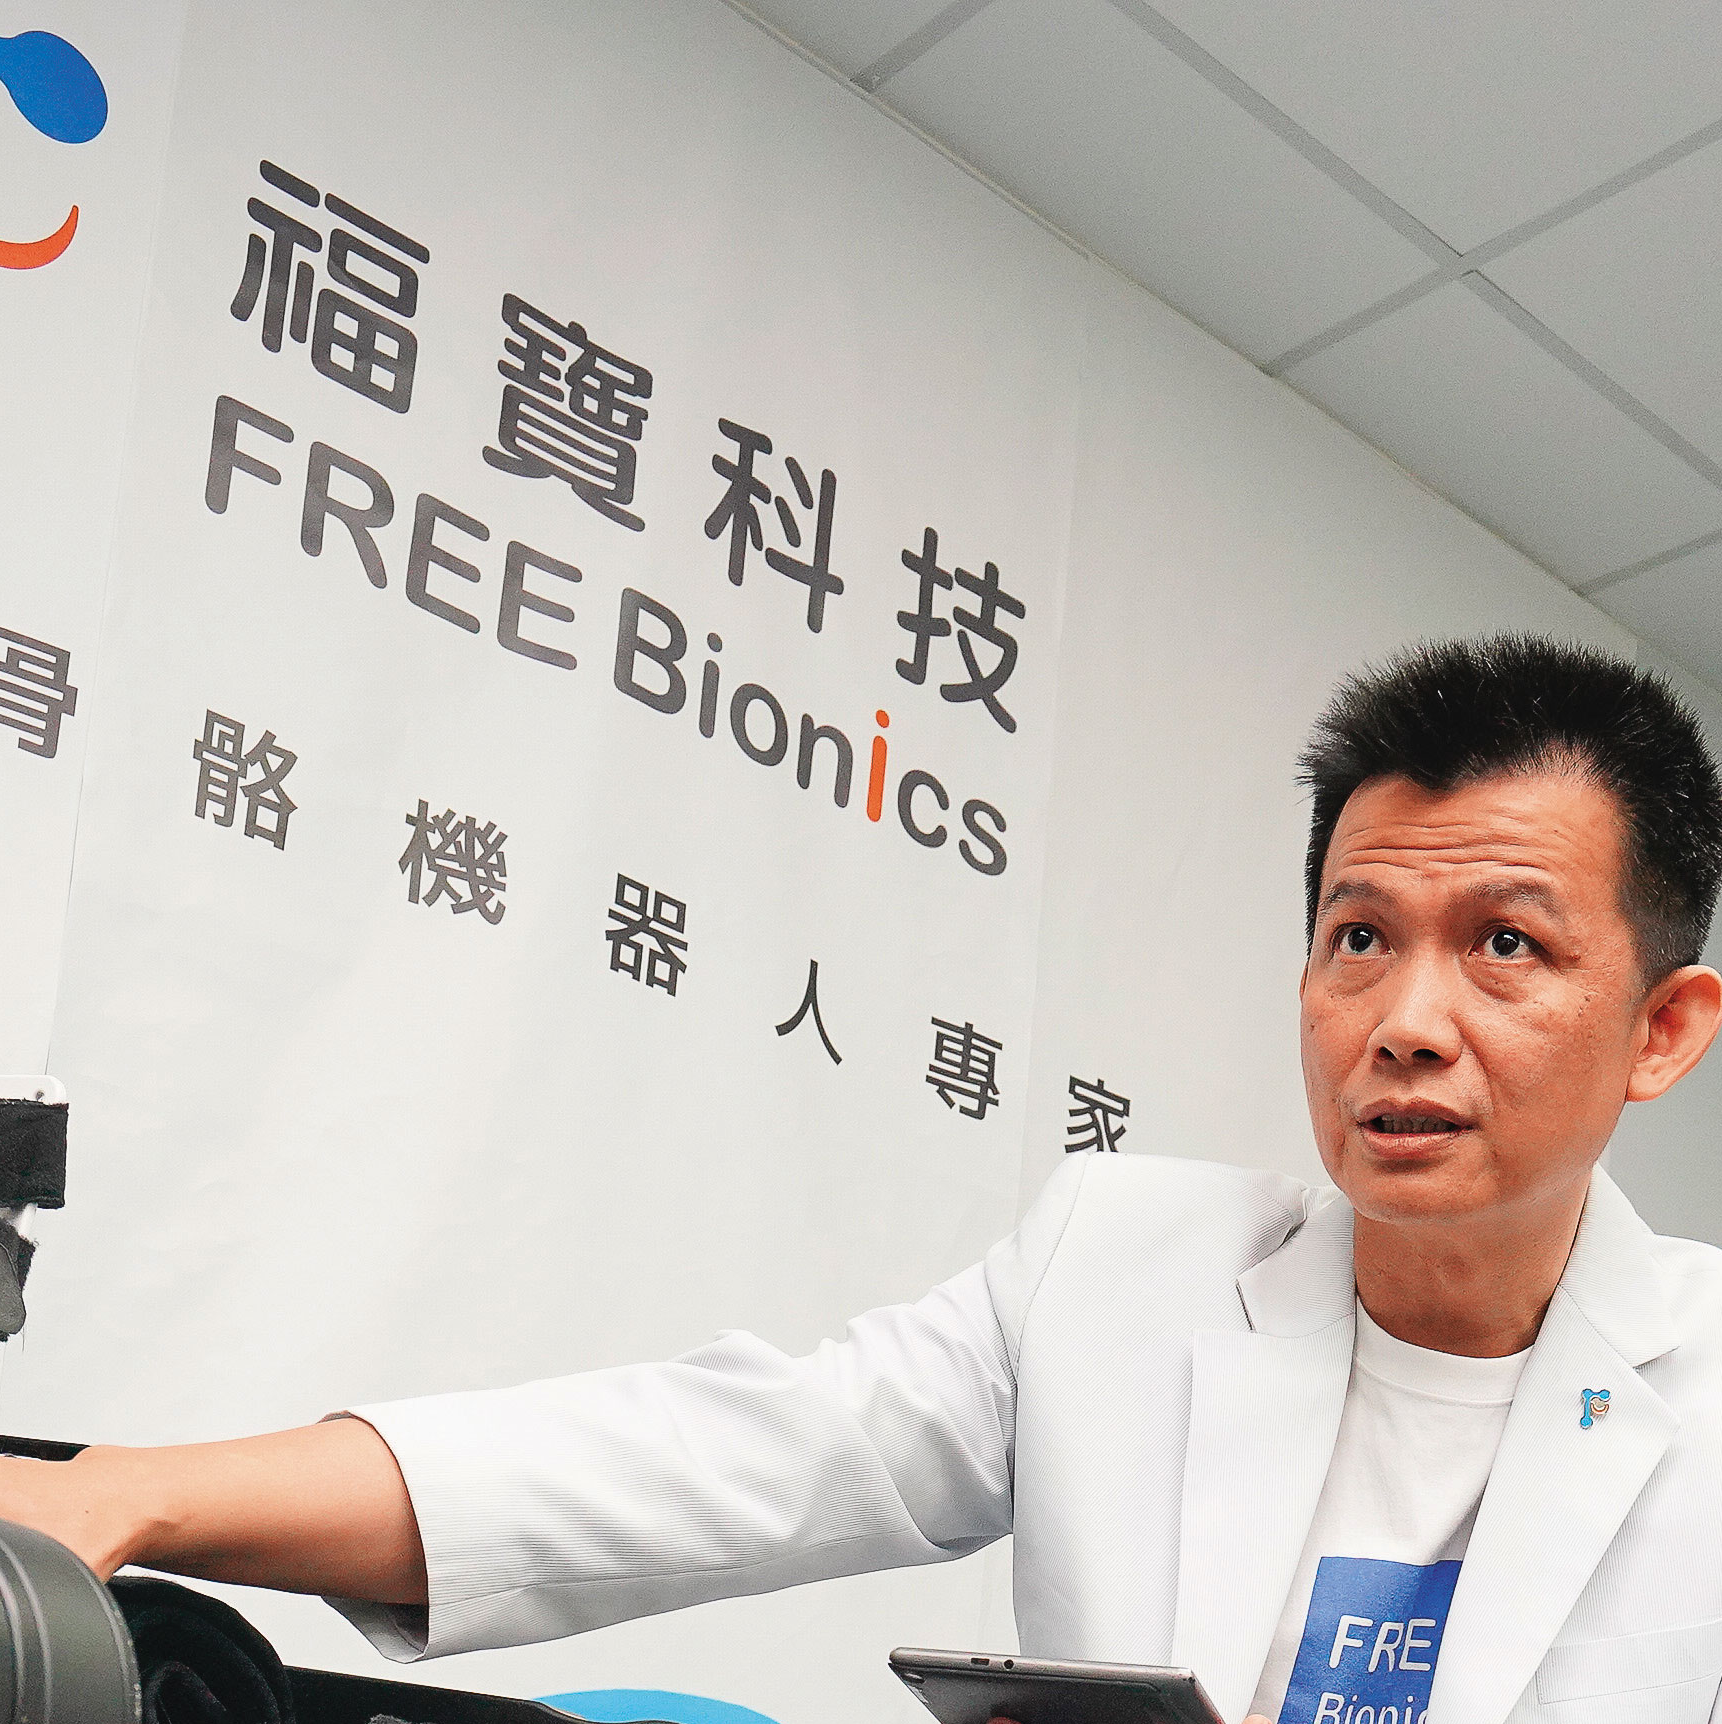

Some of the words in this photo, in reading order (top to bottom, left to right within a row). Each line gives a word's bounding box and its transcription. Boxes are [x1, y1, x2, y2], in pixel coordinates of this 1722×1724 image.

[205, 395, 582, 671] FREE
[614, 588, 1008, 876] Bionics
[230, 160, 1027, 734] 福寶科技
